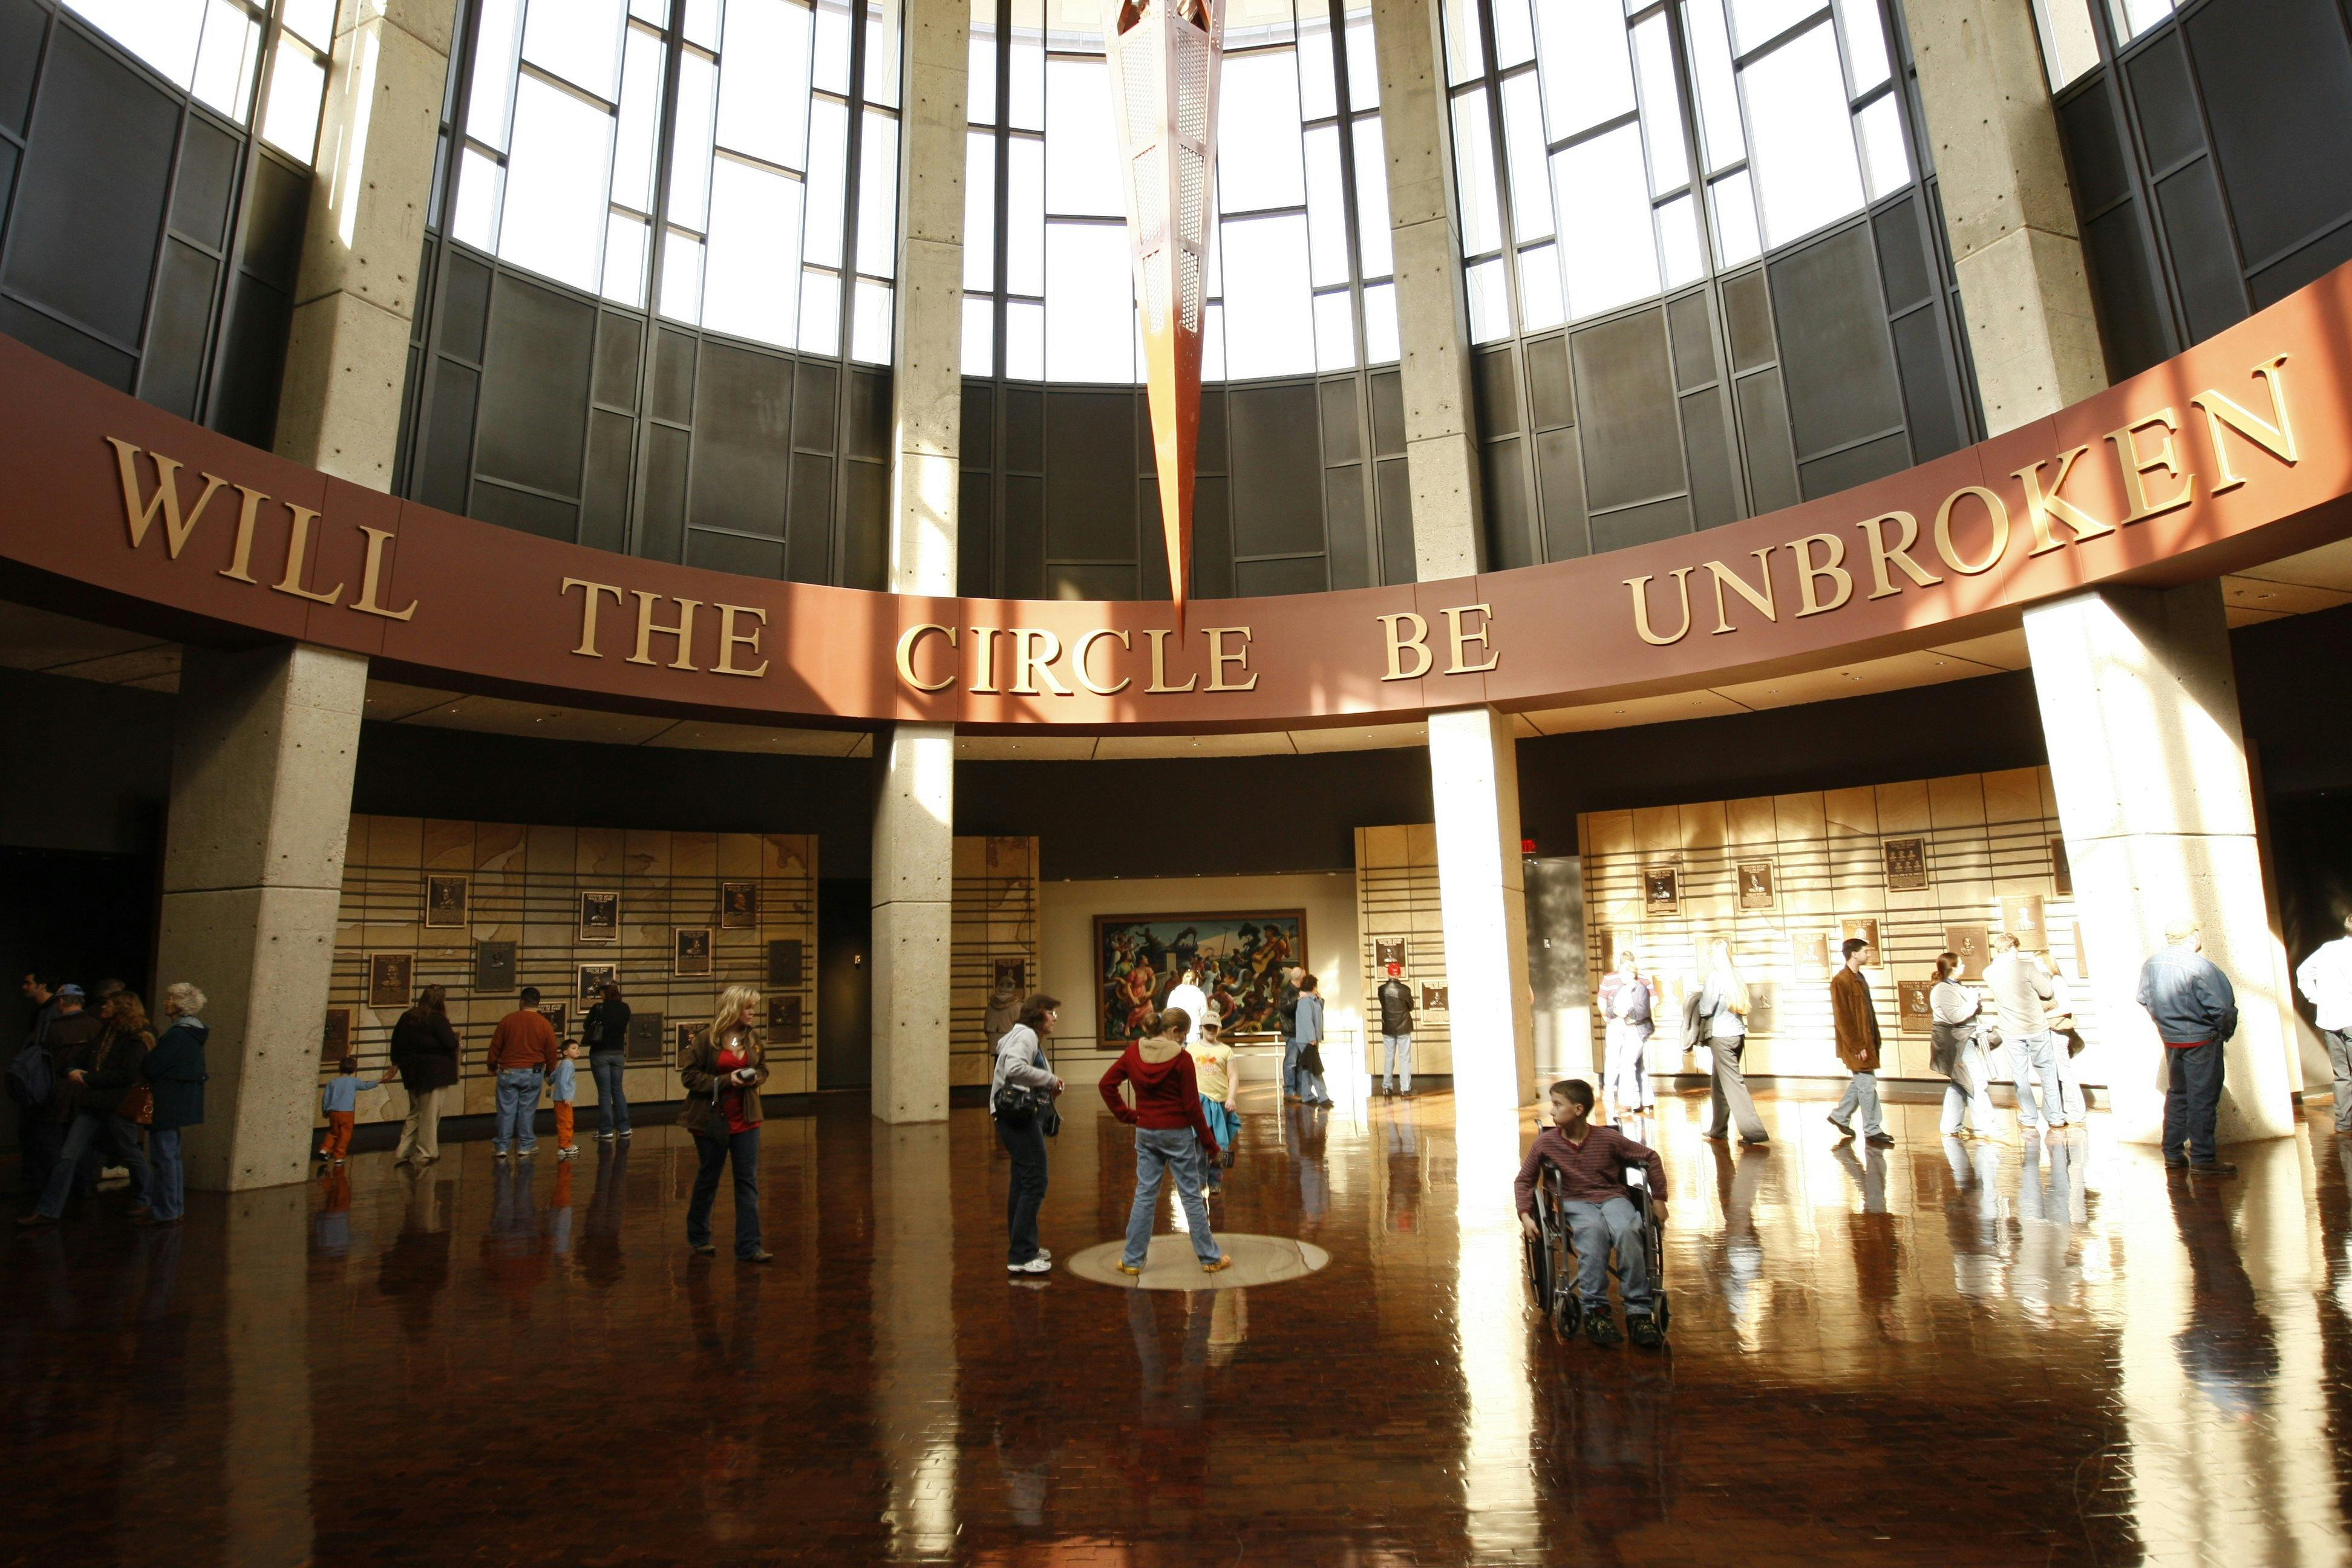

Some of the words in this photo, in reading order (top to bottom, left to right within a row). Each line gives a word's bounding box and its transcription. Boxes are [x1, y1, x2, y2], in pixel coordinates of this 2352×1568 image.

[103, 436, 419, 621] WILL
[561, 577, 769, 678] THE
[895, 623, 1258, 695] CIRCLE
[1376, 603, 1500, 681] BE
[1622, 352, 2299, 645] UNBROKEN
